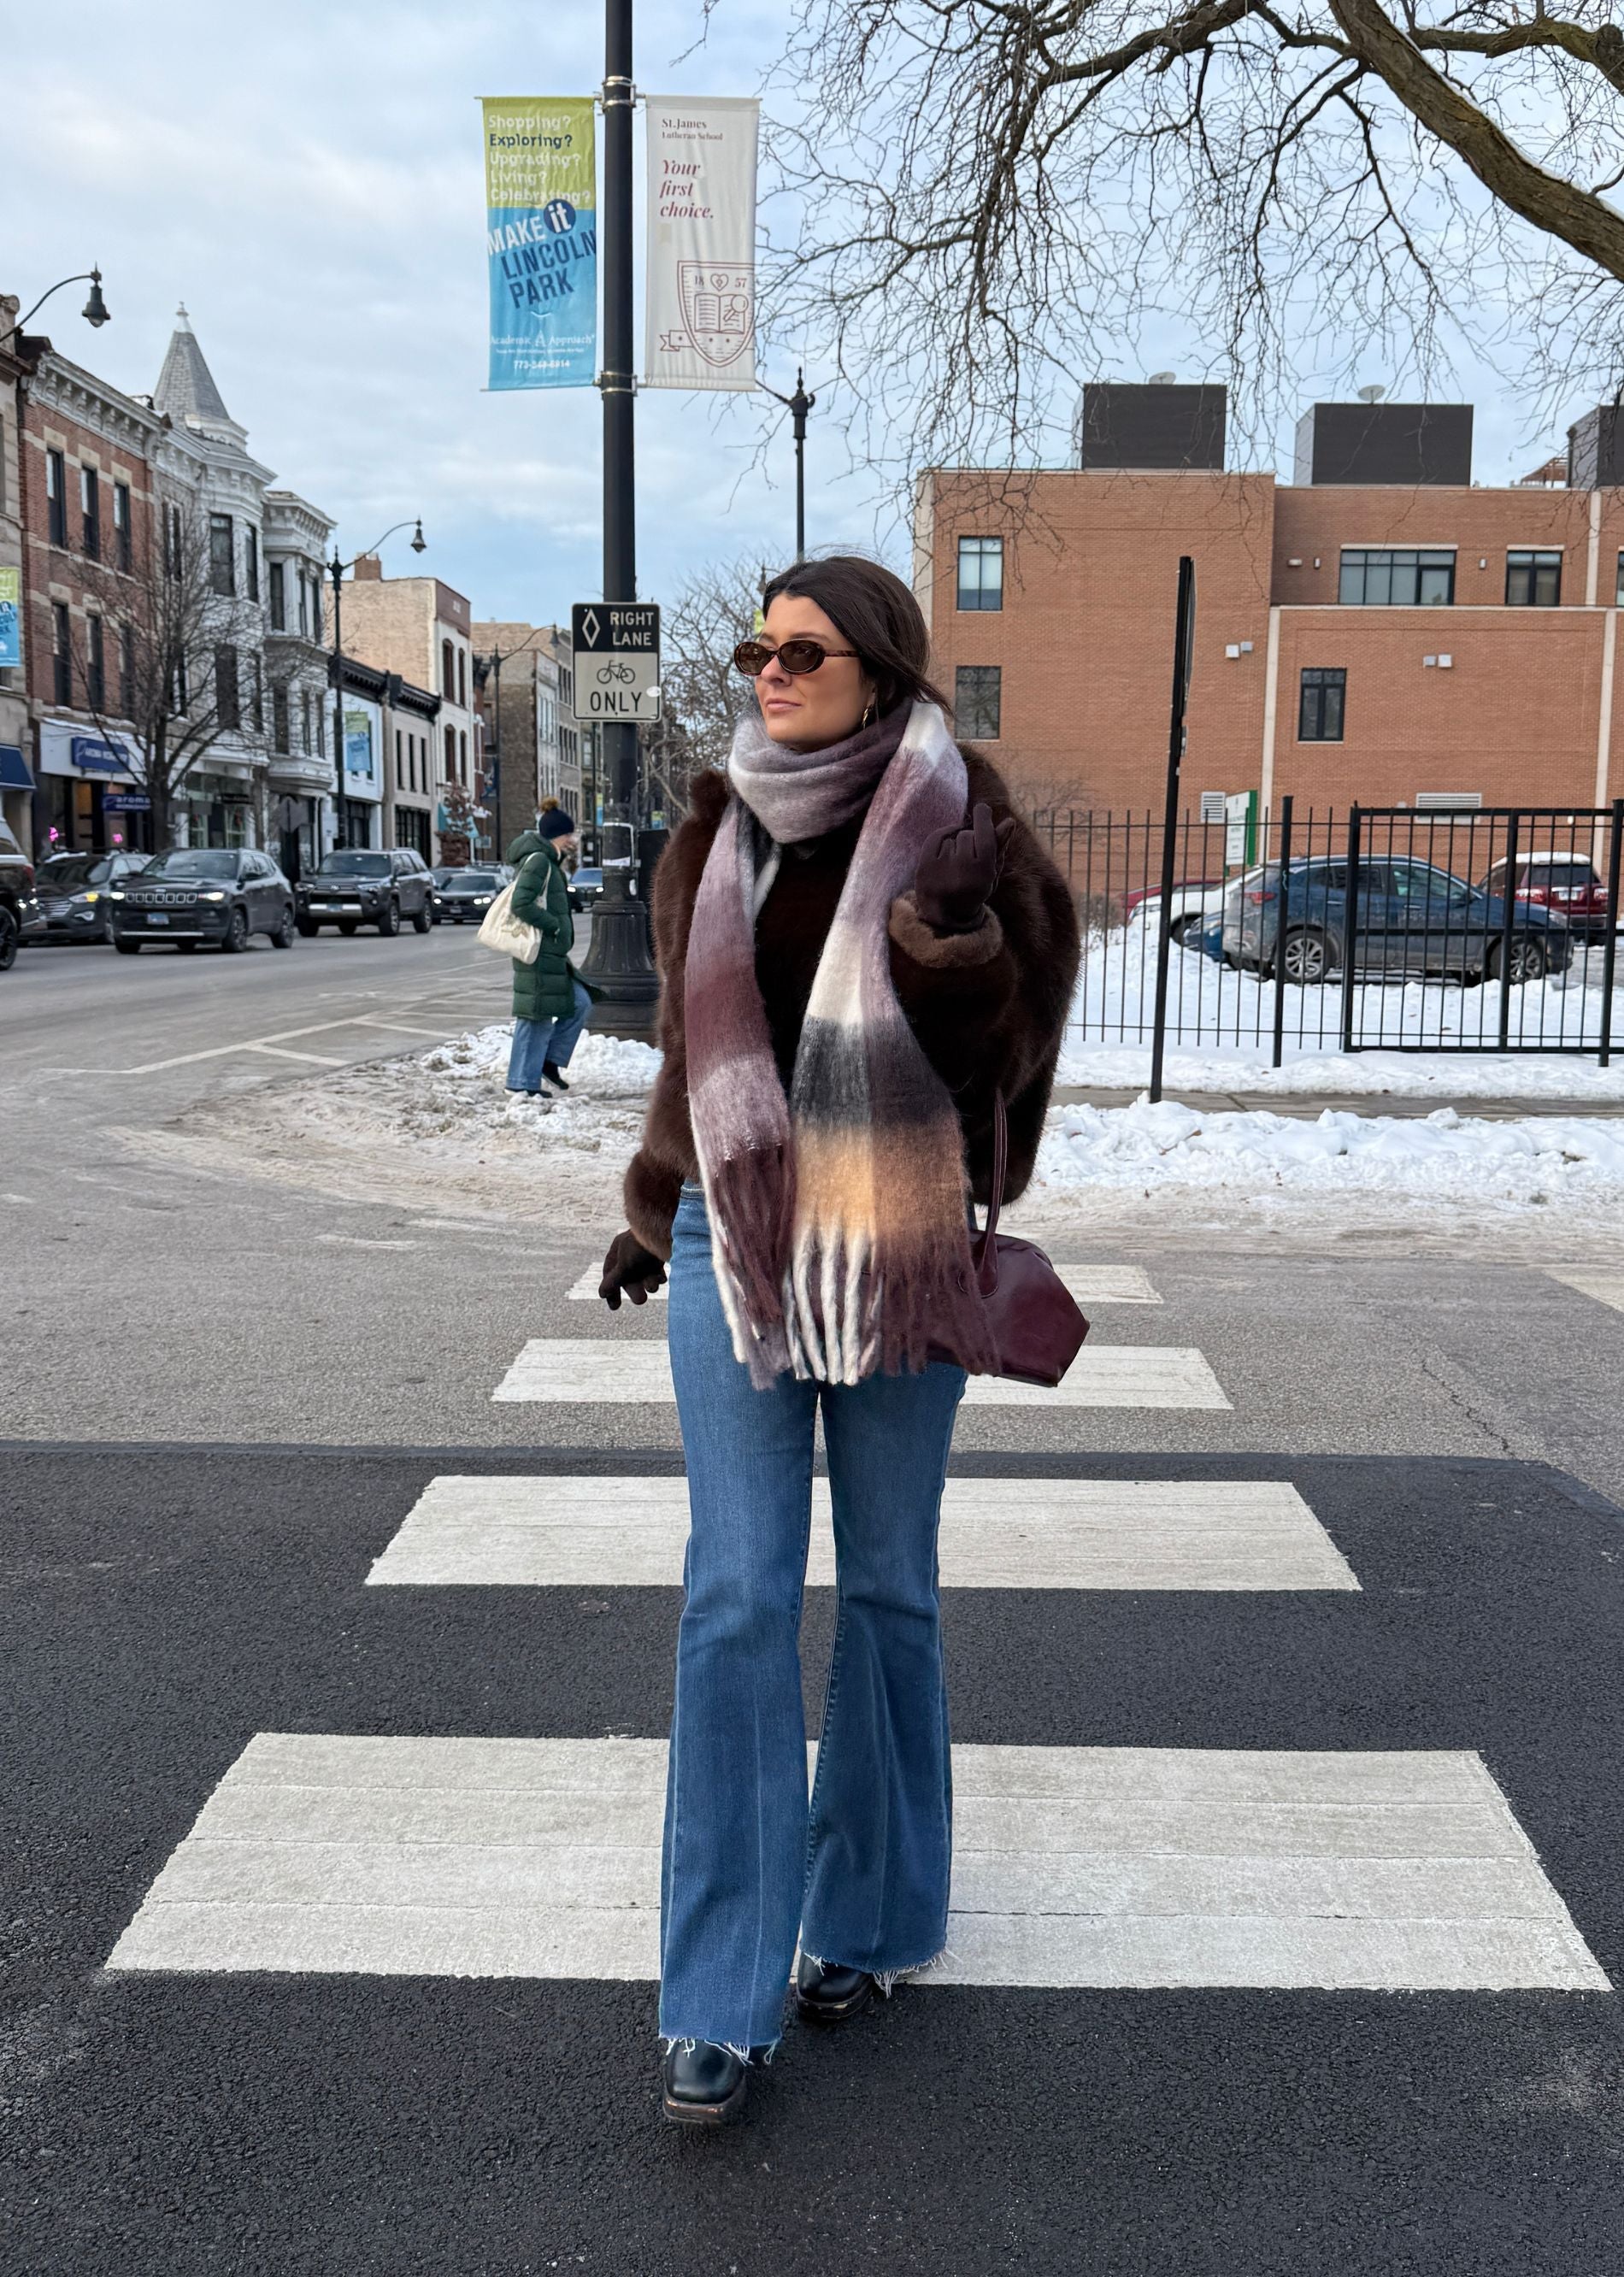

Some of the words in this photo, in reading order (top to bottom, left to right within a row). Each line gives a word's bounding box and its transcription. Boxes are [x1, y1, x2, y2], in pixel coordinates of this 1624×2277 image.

[488, 115, 571, 131] Shopping?
[489, 132, 573, 150] Exploring?
[697, 132, 723, 141] School
[490, 150, 581, 168] Upgrading?
[662, 160, 701, 175] Your
[490, 169, 547, 185] Living?
[491, 187, 591, 204] Celebrating?
[659, 180, 693, 198] first
[660, 201, 714, 219] choice.
[487, 215, 547, 256] MAKE
[548, 202, 572, 233] it
[500, 229, 596, 279] LINCOLN
[509, 268, 574, 309] PARK
[609, 611, 655, 626] RIGHT
[612, 632, 652, 646] LANE
[590, 691, 643, 713] ONLY
